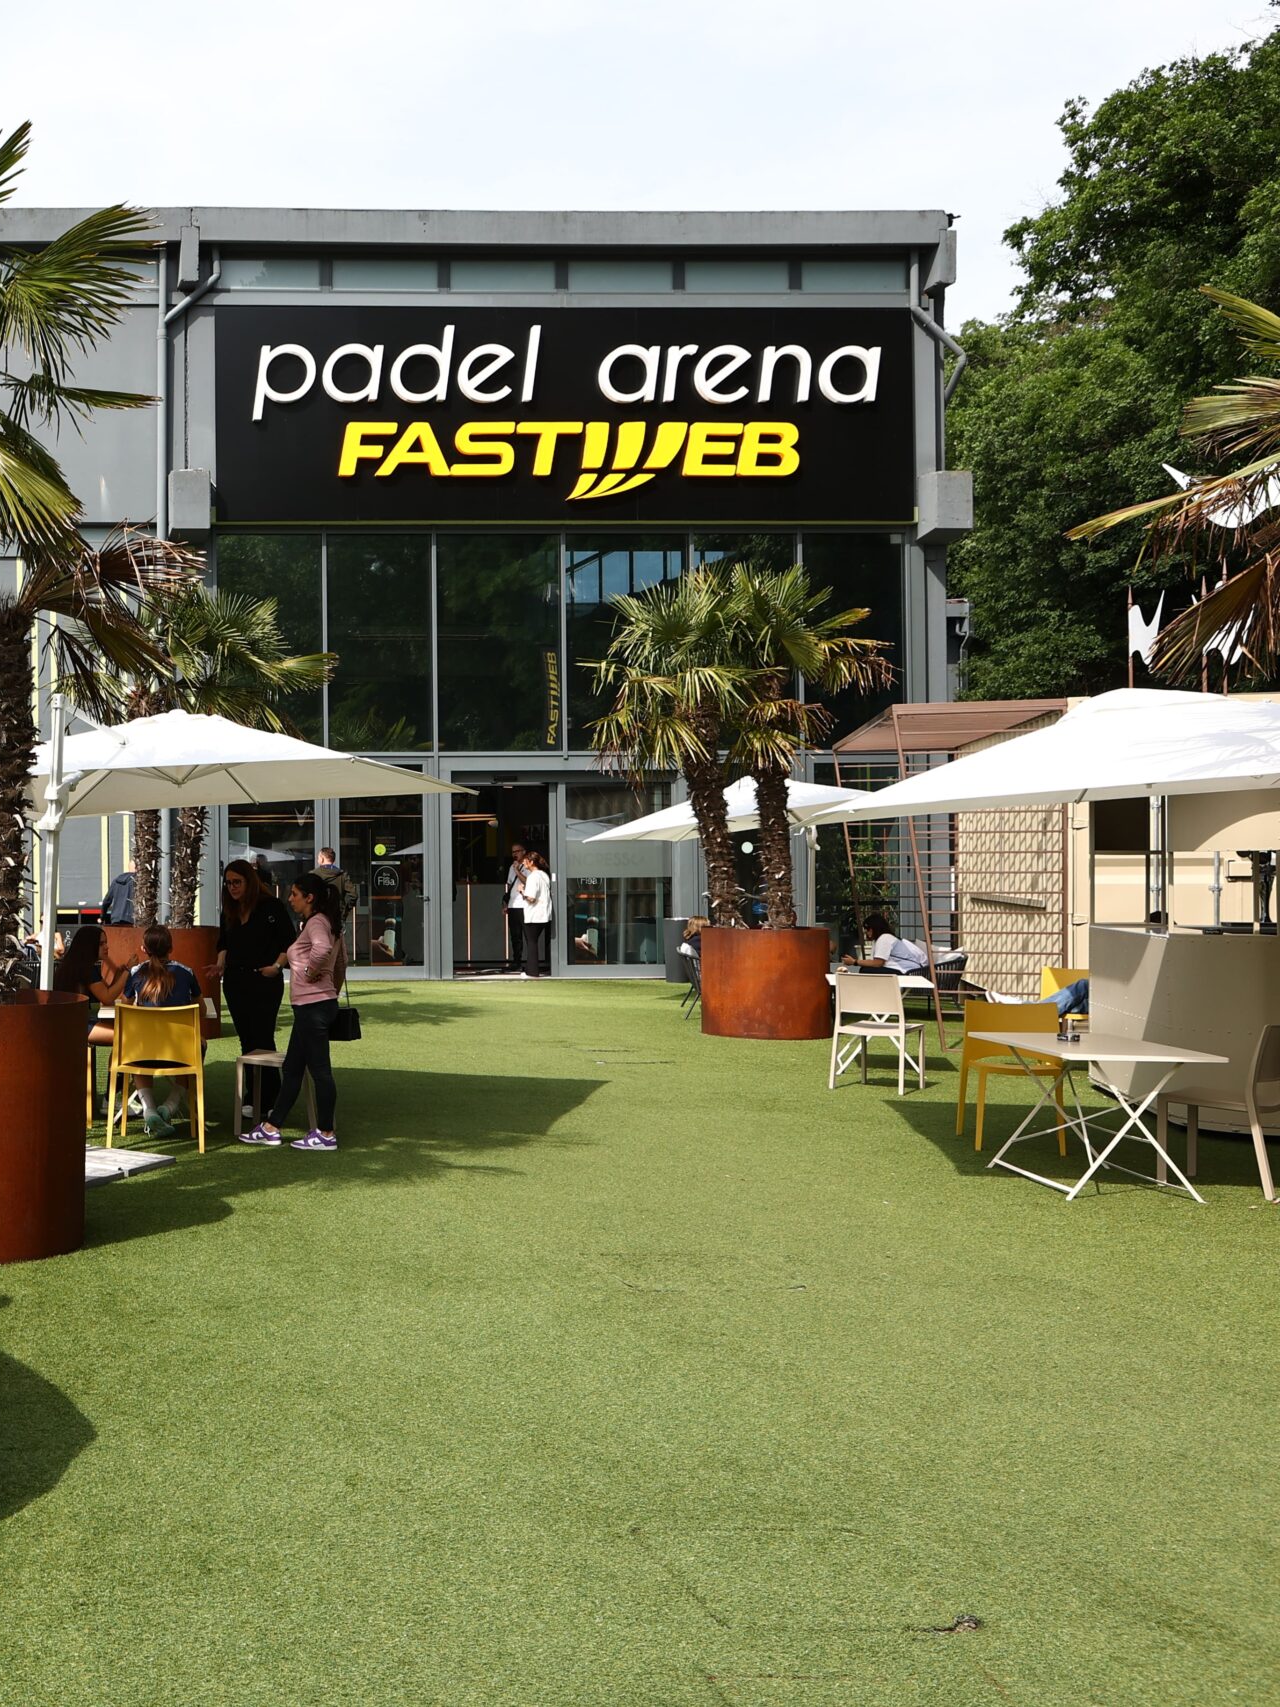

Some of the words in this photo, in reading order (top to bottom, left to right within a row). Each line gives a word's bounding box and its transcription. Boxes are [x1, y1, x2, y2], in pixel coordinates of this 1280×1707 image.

[252, 324, 541, 422] padel
[597, 343, 882, 404] arena
[337, 421, 801, 501] FASTWEB
